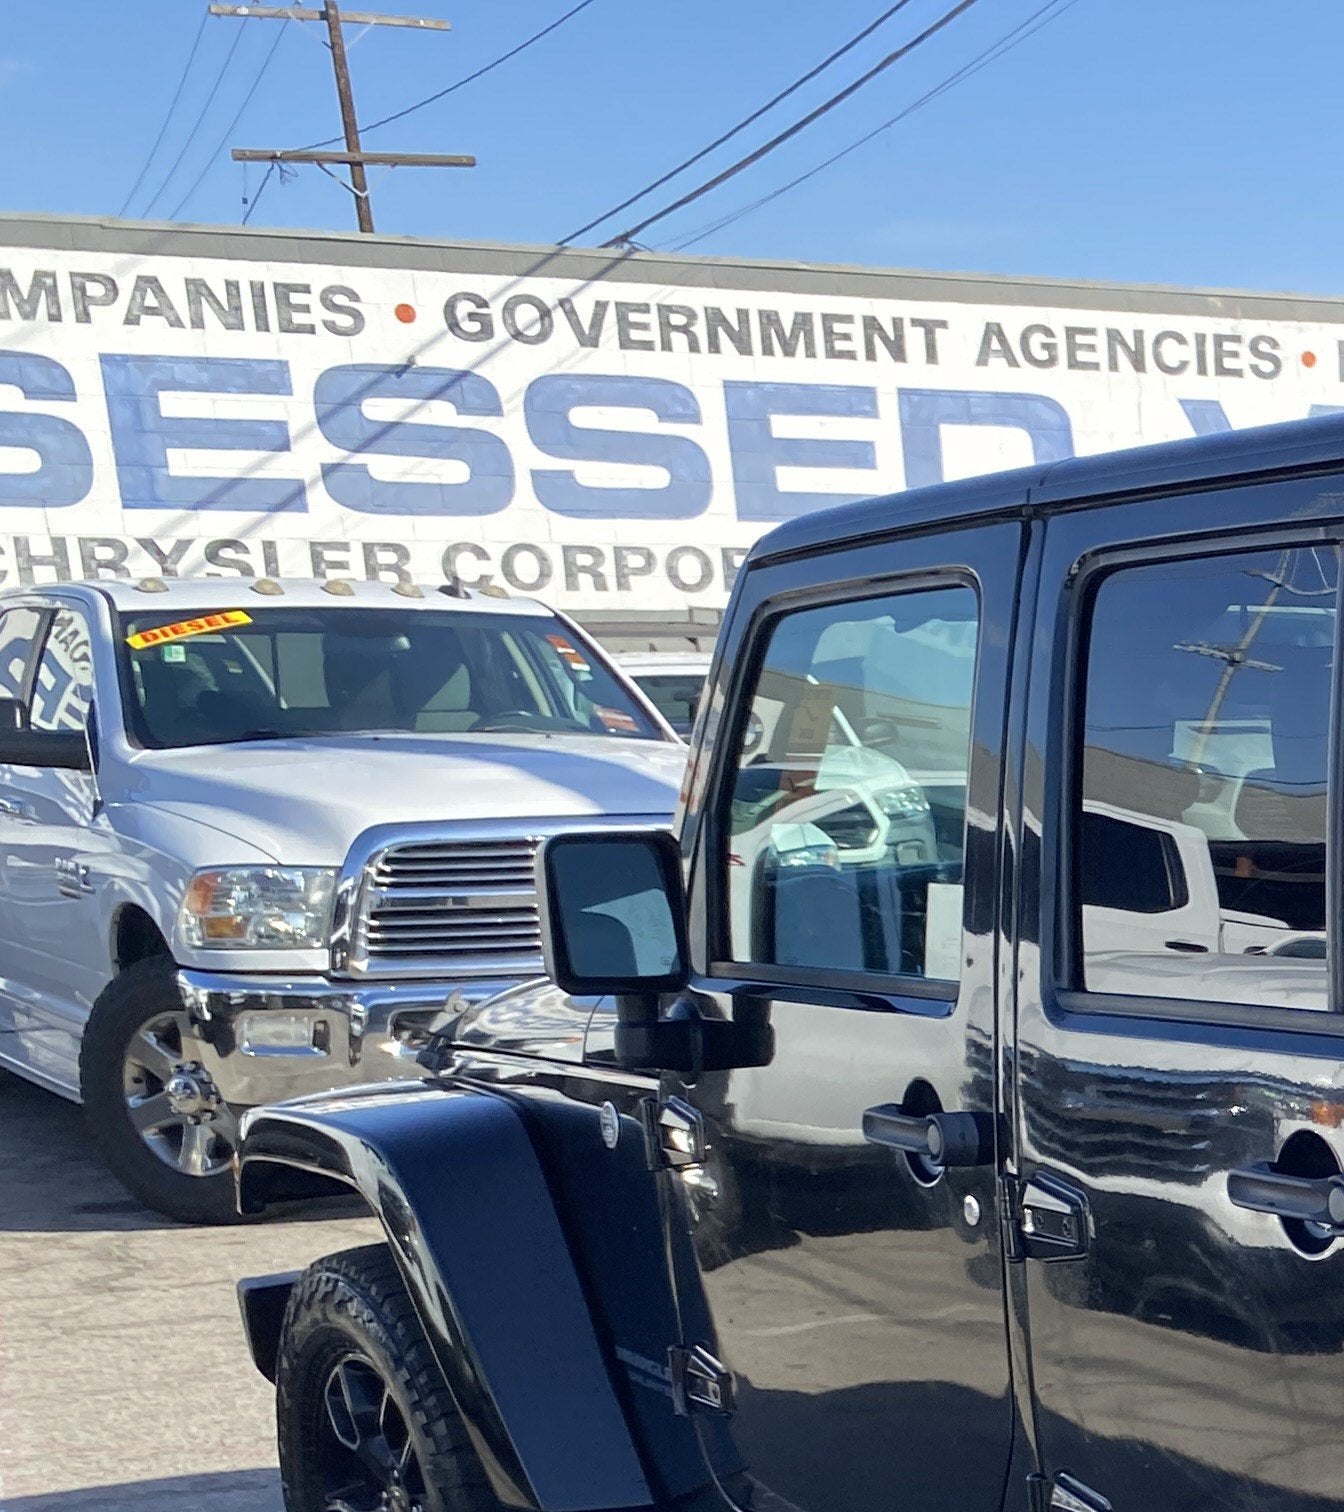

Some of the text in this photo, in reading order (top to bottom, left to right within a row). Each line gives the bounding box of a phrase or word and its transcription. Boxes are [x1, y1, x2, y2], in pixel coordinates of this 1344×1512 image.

[443, 291, 949, 364] GOVERNMENT
[975, 322, 1283, 380] AGENCIES
[0, 536, 412, 588] HRYSLER
[140, 612, 242, 645] DIESEL
